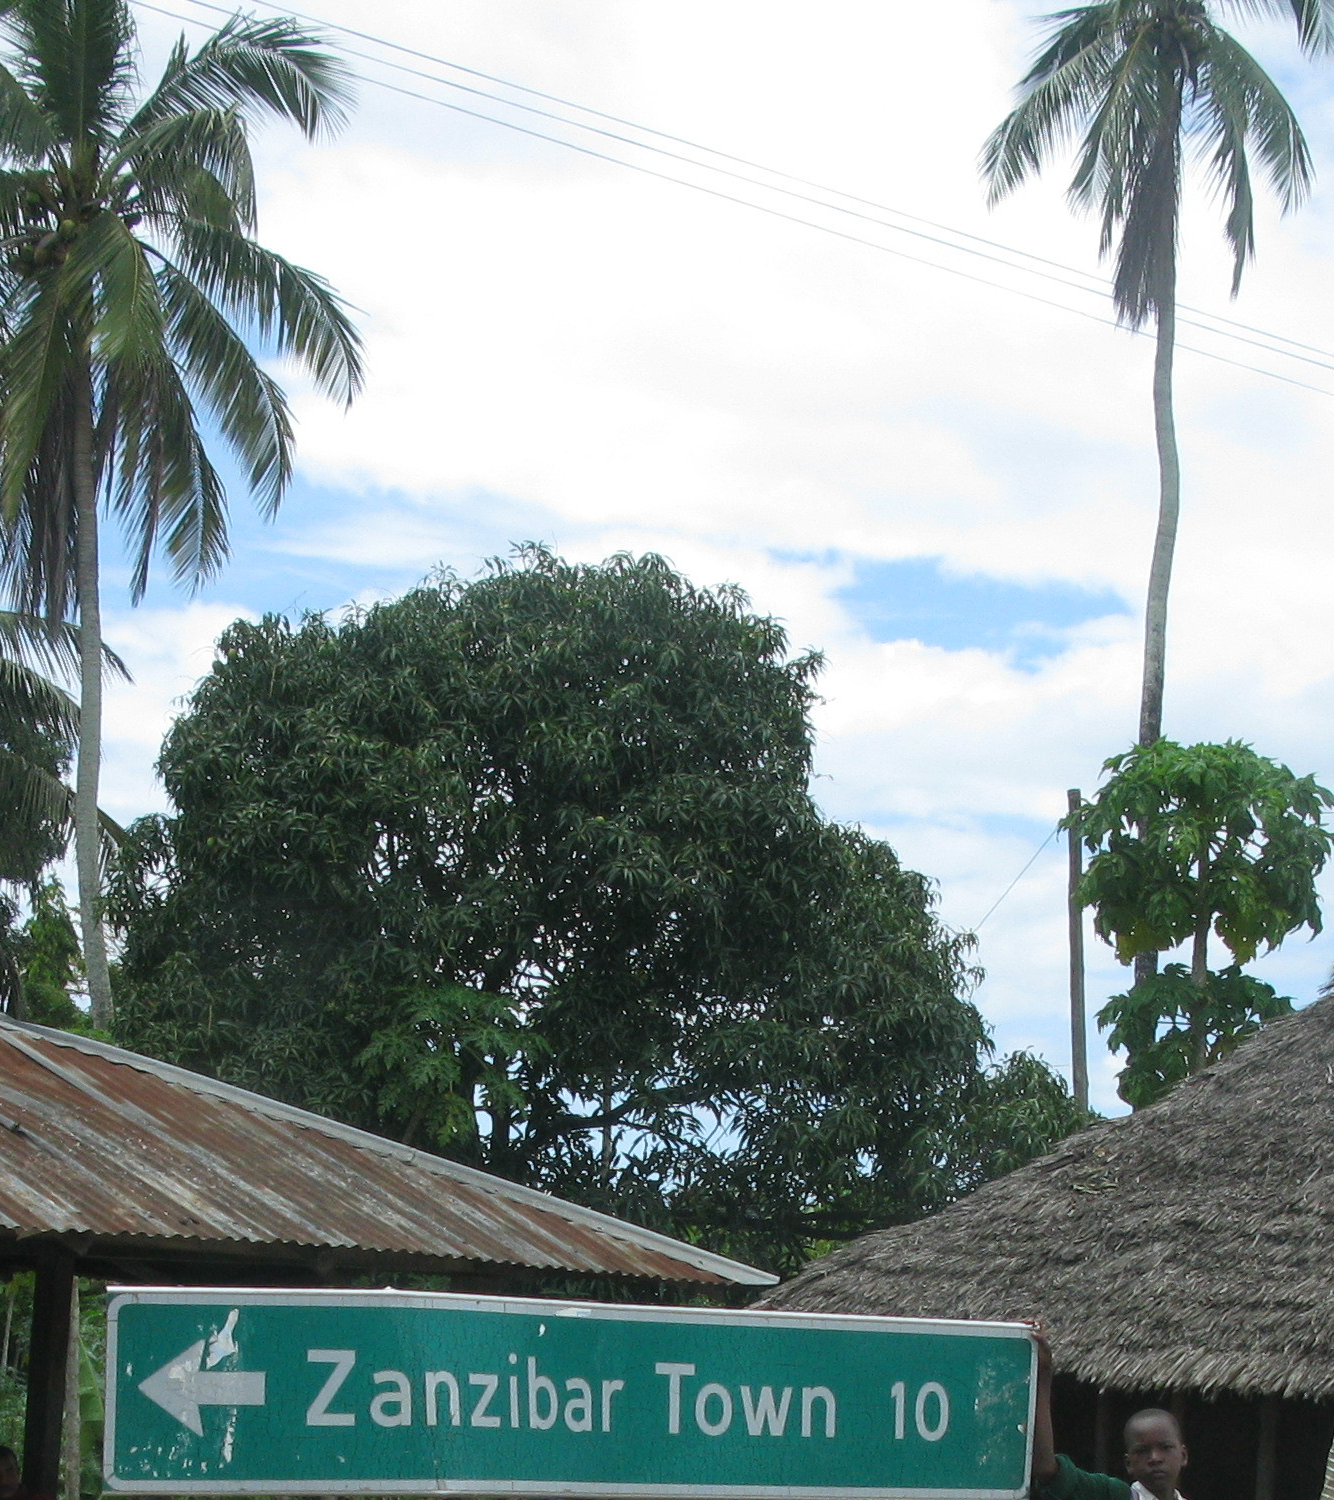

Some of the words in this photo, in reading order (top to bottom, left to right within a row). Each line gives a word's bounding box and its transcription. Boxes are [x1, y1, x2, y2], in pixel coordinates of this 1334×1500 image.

[306, 1349, 625, 1432] Zanzibar
[655, 1362, 837, 1438] Town
[890, 1381, 949, 1441] 10
